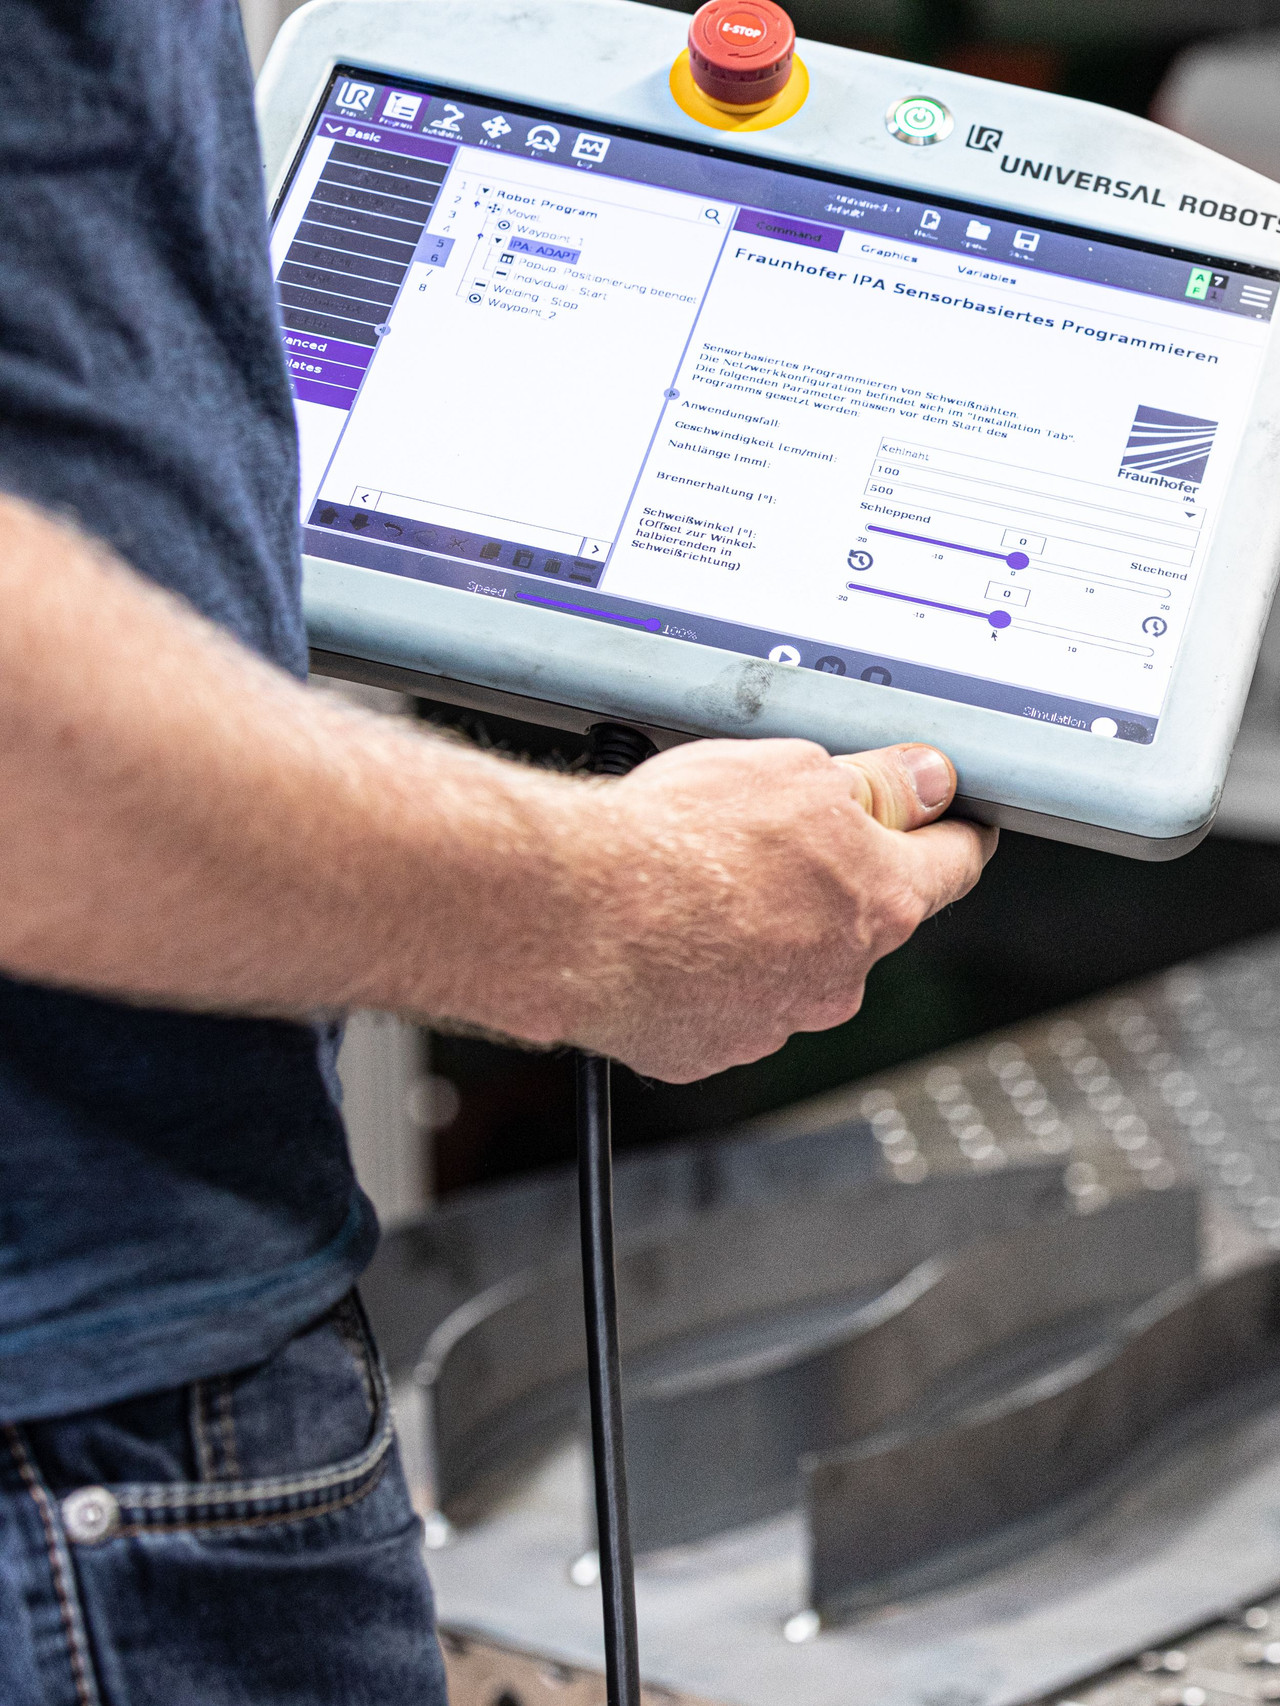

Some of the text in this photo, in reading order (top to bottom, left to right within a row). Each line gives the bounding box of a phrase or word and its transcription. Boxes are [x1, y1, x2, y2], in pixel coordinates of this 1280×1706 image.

[721, 22, 762, 38] E-STOP
[345, 127, 382, 143] Basic
[1000, 155, 1166, 208] UNIVERSAL
[497, 189, 598, 219] Robot Program
[756, 221, 823, 243] Command
[536, 245, 579, 262] ADAPT
[860, 244, 919, 264] Graphics
[513, 273, 568, 292] Individual
[579, 286, 608, 301] Start
[564, 267, 647, 295] Positionierung
[957, 265, 1017, 286] Variables
[493, 283, 540, 303] Welding
[551, 296, 579, 310] Stop
[735, 247, 1220, 365] Fraunhofer IPA Sensorbasiertes Programmieren
[702, 342, 800, 370] Sensorbasiertes
[802, 363, 898, 392] Programmieren
[901, 387, 922, 397] von
[692, 373, 763, 396] Programms
[699, 353, 720, 364] Die
[866, 389, 915, 408] befindet
[919, 401, 945, 413] sich
[695, 363, 1008, 439] Die folgenden Parameter müssen vor dem Start des
[674, 420, 775, 448] Geschwindigkeit
[668, 438, 731, 460] Nahtlänge
[881, 443, 930, 462] Kehlnaht
[877, 464, 900, 477] 100
[1117, 467, 1200, 495] Fraunhofer
[656, 470, 754, 501] Brennerhaltung
[869, 484, 894, 496] 500
[642, 506, 735, 534] Schweißwinkel
[859, 501, 932, 524] Schleppend
[635, 528, 717, 554] halbierenden
[685, 529, 707, 539] zur
[1130, 561, 1188, 582] Stechend
[466, 580, 507, 598] Speed
[662, 623, 698, 641] 100%
[1023, 705, 1087, 730] Simulation
